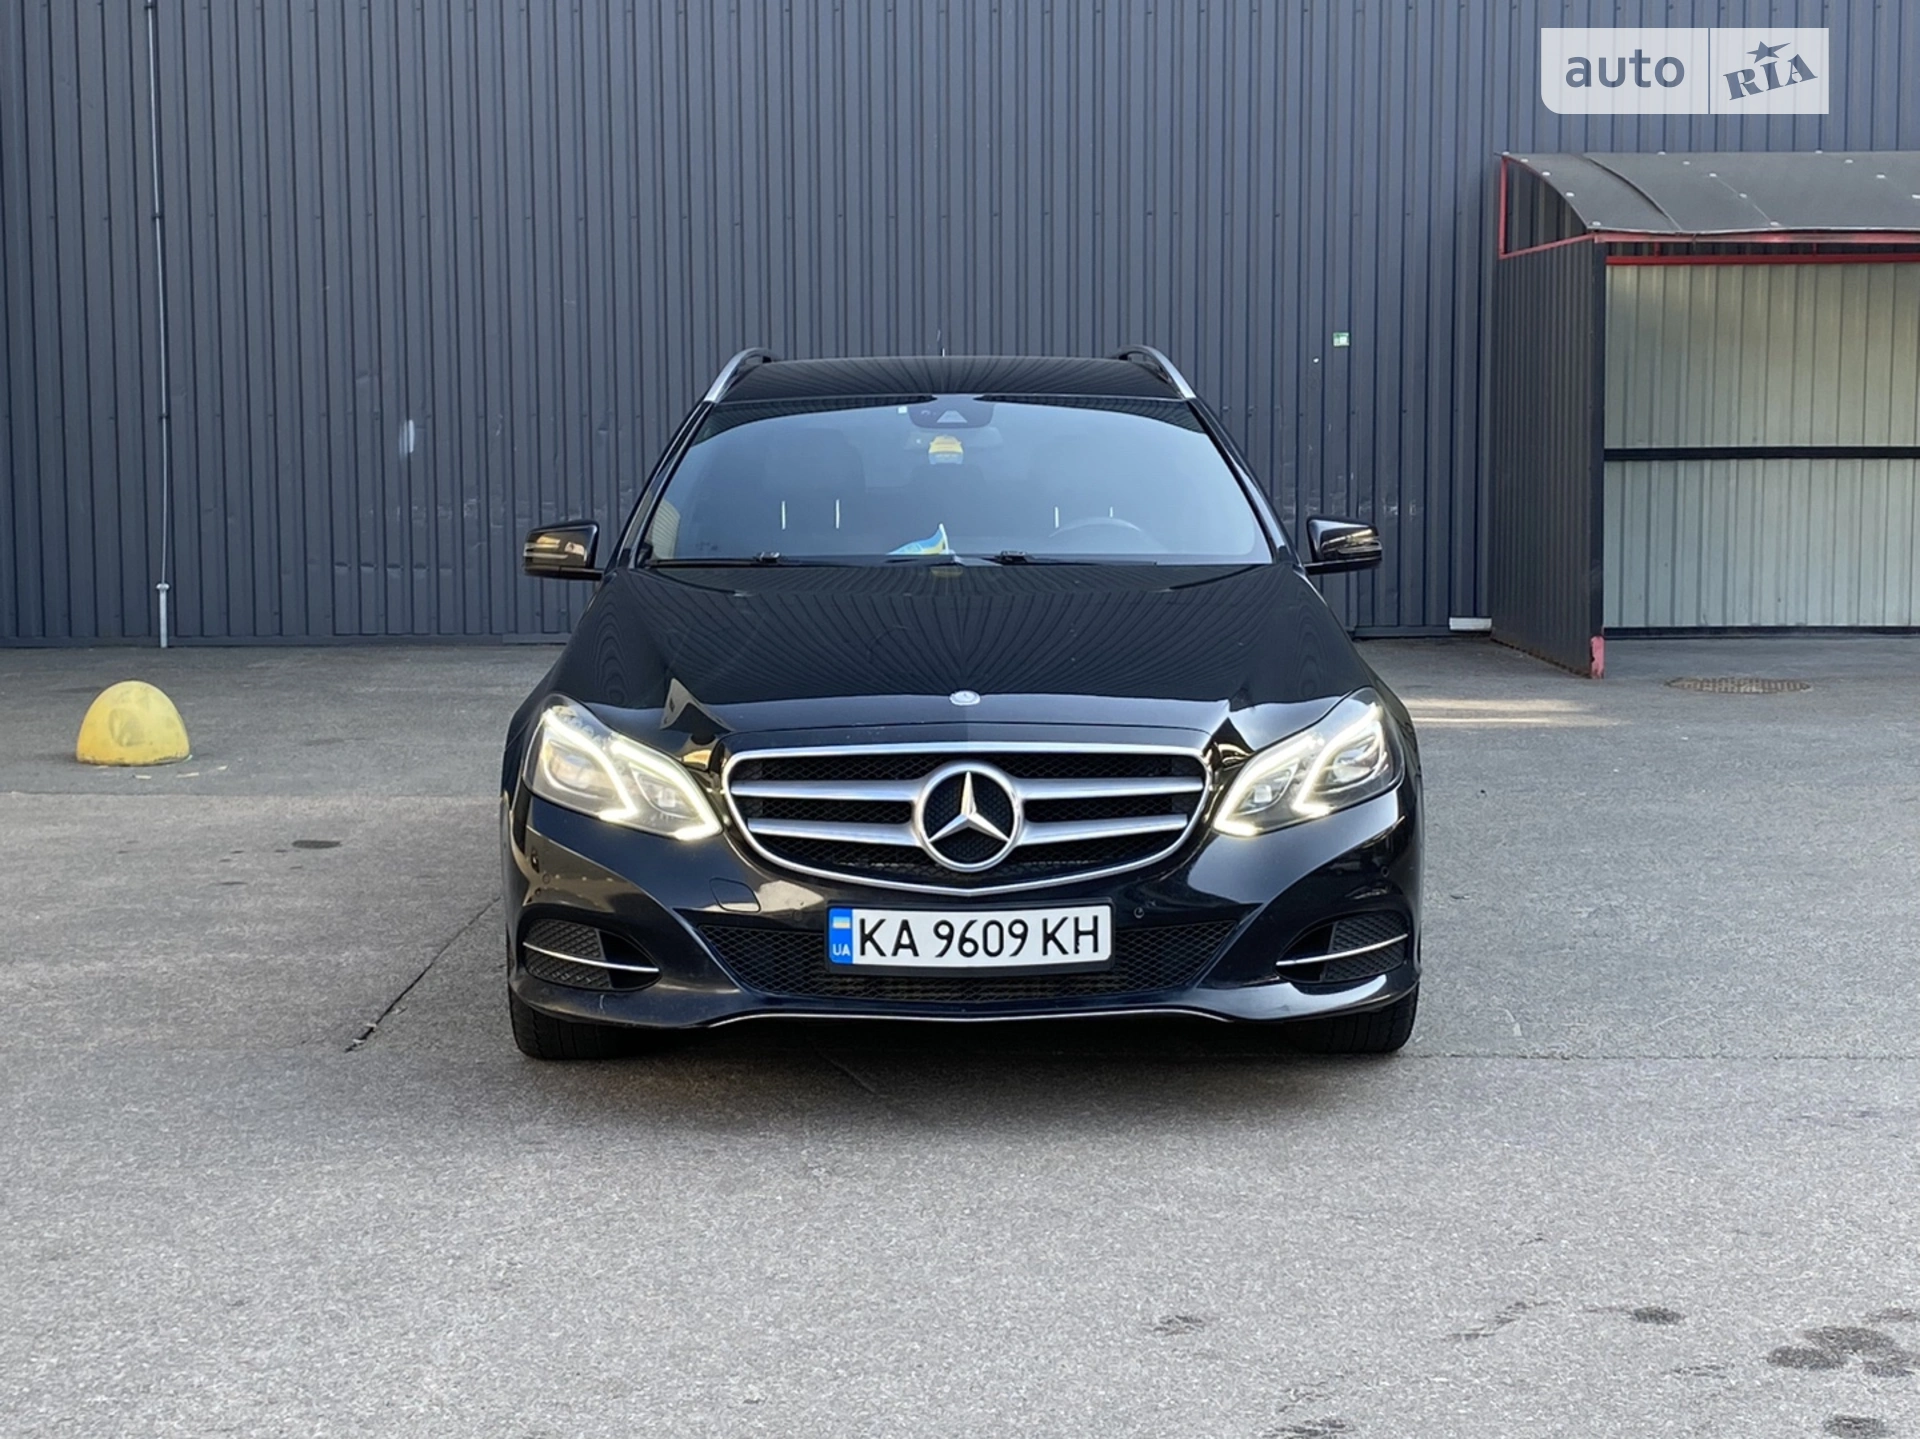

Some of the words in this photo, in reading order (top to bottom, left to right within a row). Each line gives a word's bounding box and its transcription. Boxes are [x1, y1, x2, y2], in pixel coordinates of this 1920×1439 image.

[832, 943, 851, 957] UA
[859, 918, 919, 957] KA
[933, 918, 1029, 958] 9609
[1042, 915, 1099, 957] KH
